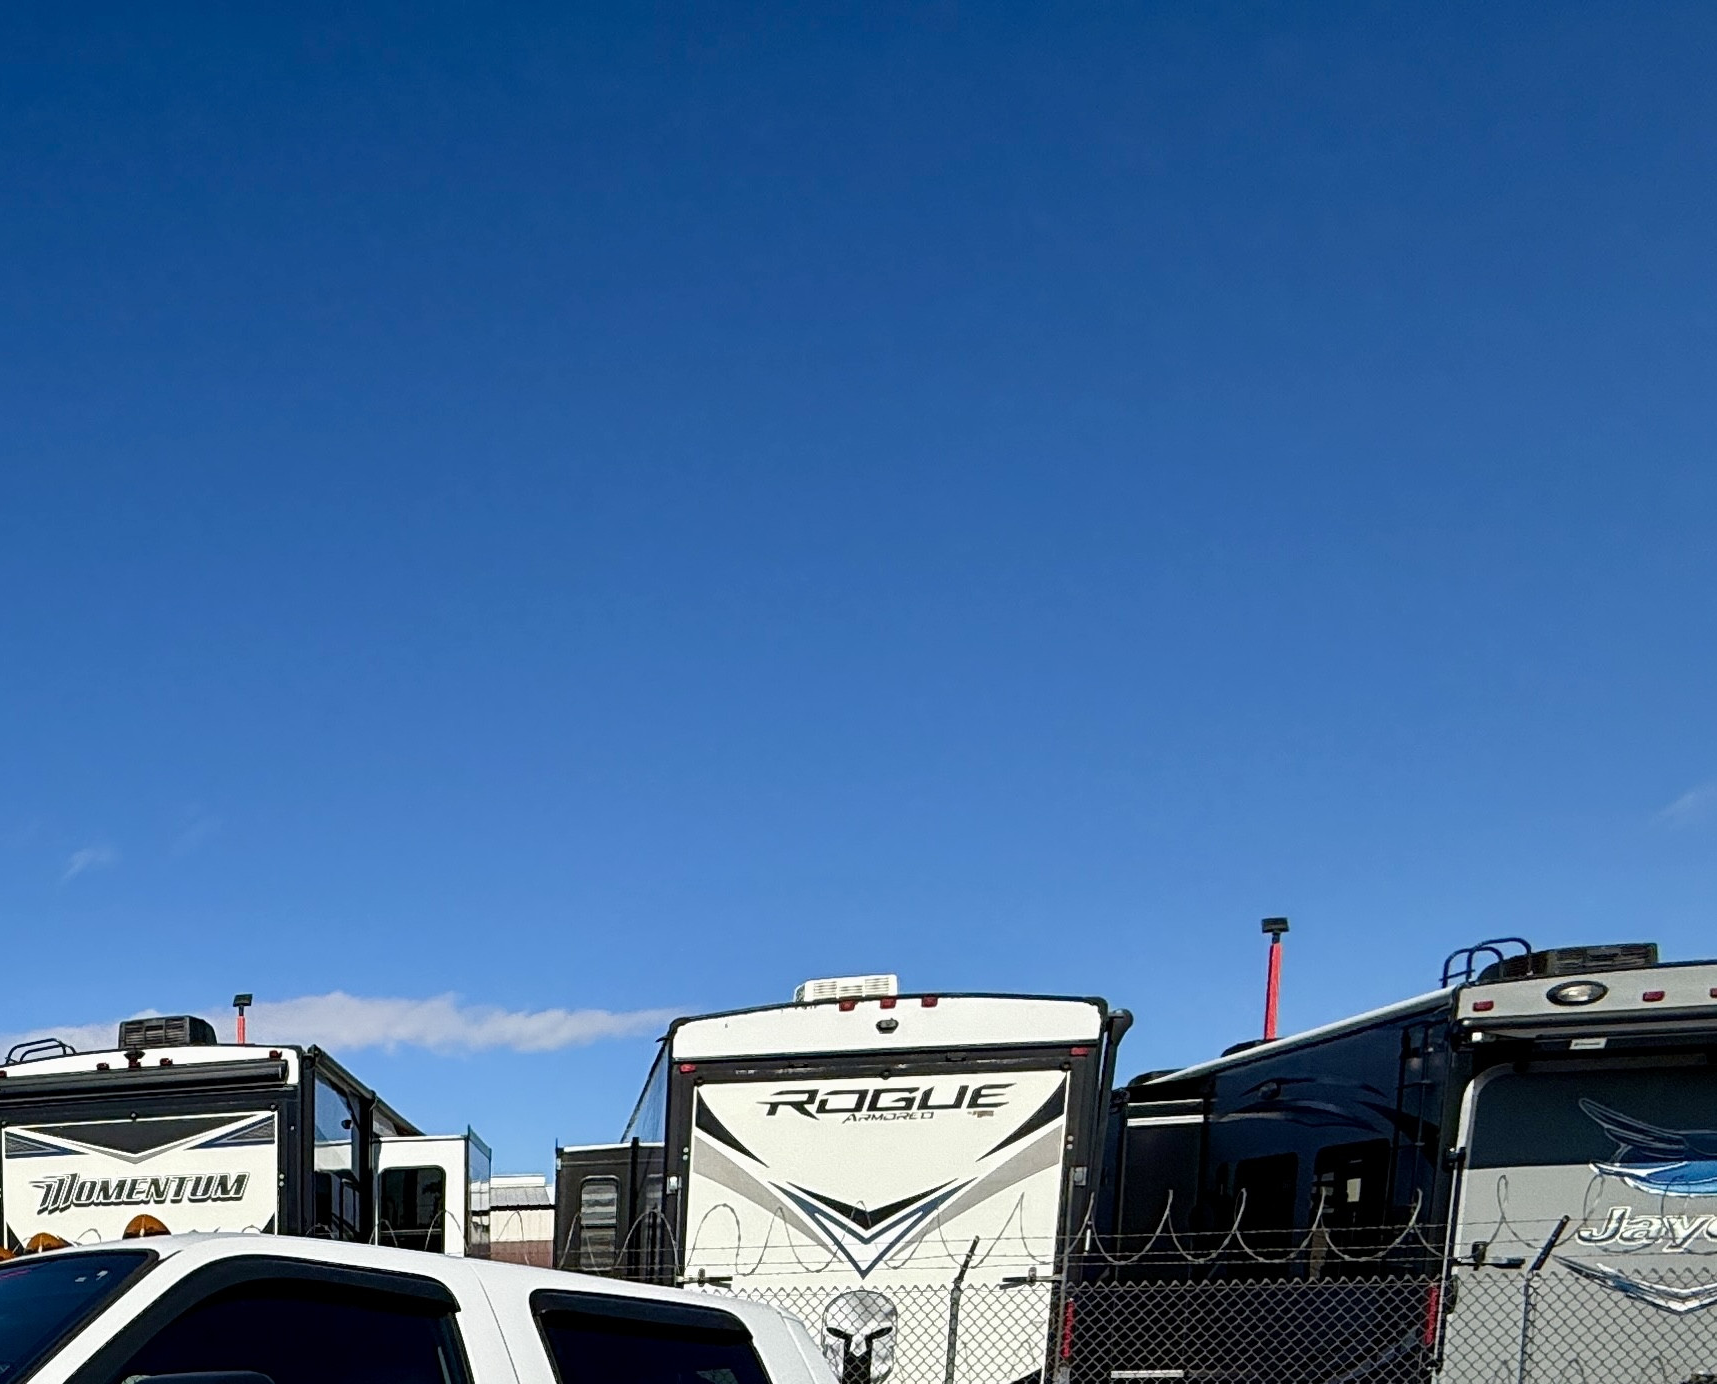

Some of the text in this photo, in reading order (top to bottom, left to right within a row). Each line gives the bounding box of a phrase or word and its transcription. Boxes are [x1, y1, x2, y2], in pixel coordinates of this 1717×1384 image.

[756, 1083, 1017, 1120] ROGUE
[842, 1111, 934, 1124] ARMORED
[29, 1172, 250, 1215] MOMENTUM
